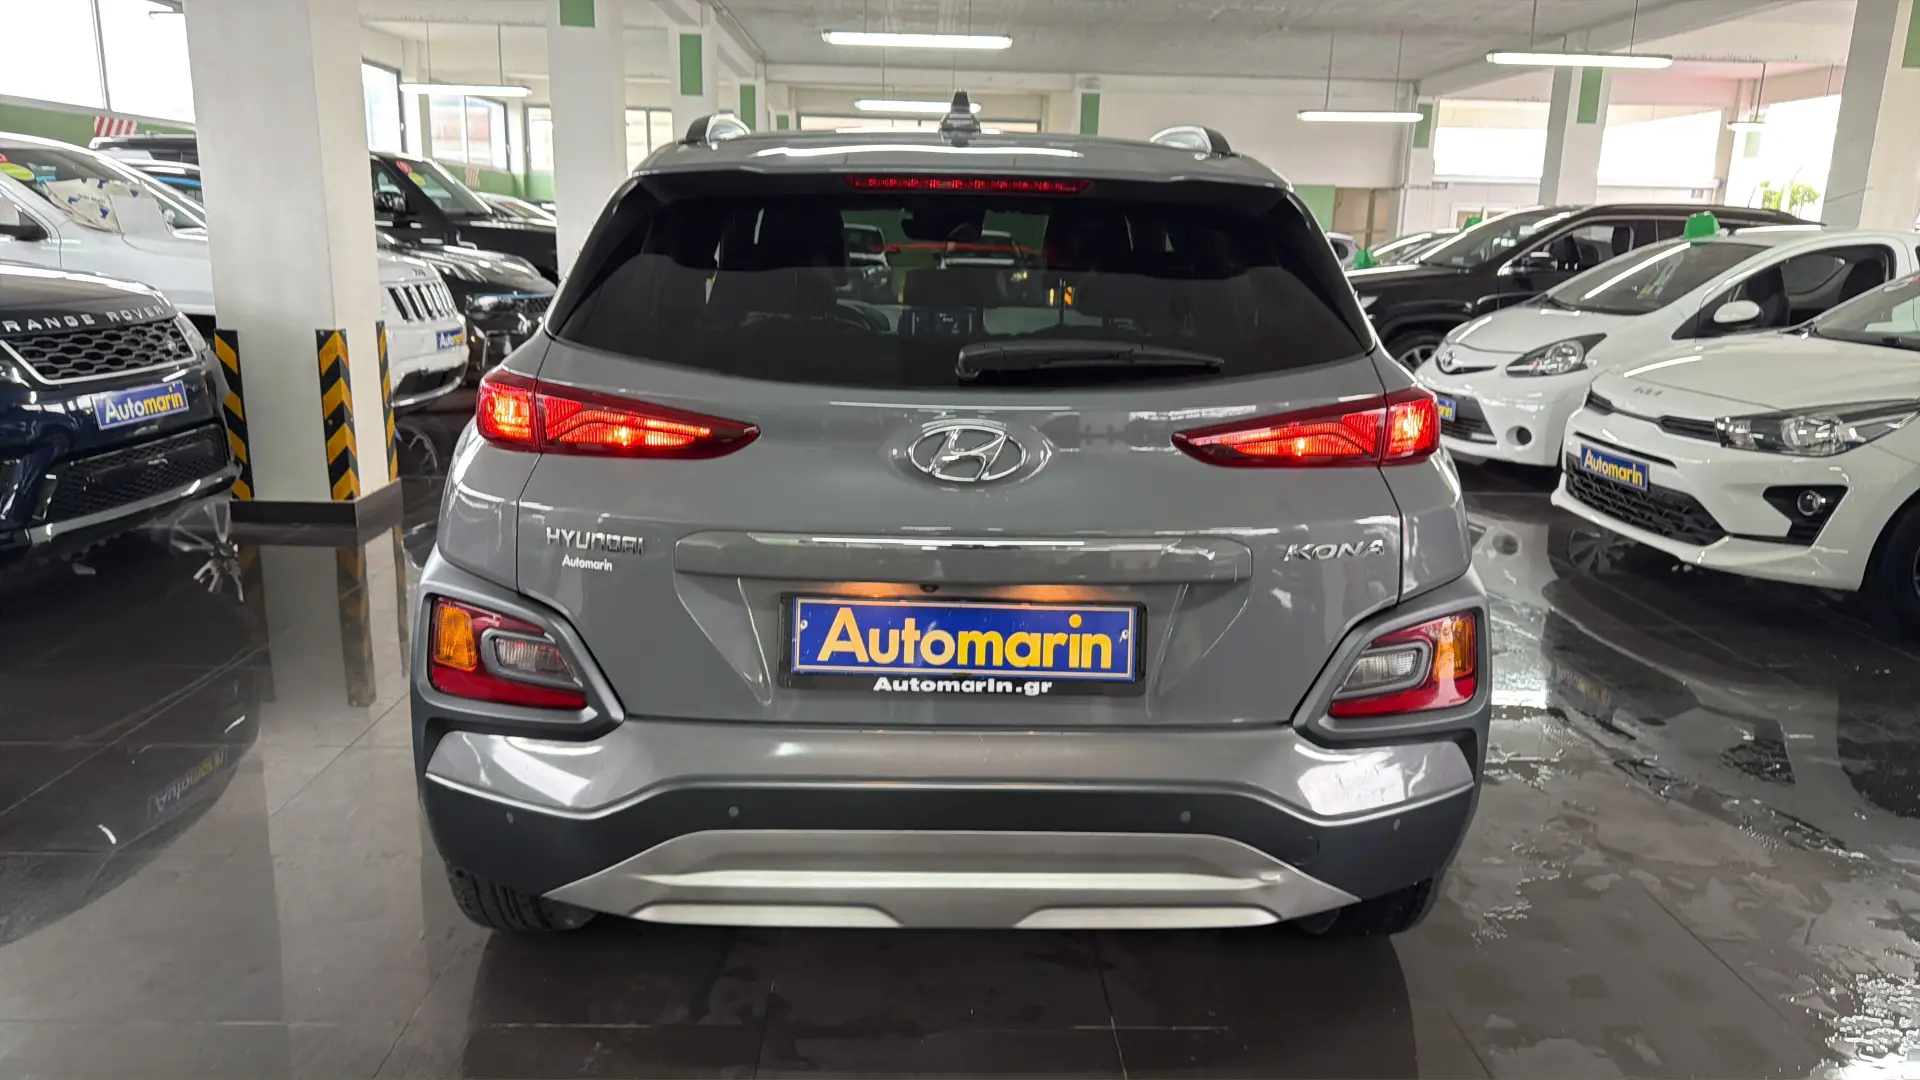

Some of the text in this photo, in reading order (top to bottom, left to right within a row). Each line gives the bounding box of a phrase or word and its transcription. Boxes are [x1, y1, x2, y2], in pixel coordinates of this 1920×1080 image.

[2, 306, 164, 332] RANGE ROVER
[105, 386, 184, 424] Automarin
[1583, 447, 1643, 486] Automarin
[546, 526, 644, 555] HYUNDAI
[1283, 539, 1385, 562] KONA
[562, 554, 613, 572] Automarin
[817, 607, 1112, 669] Automarin
